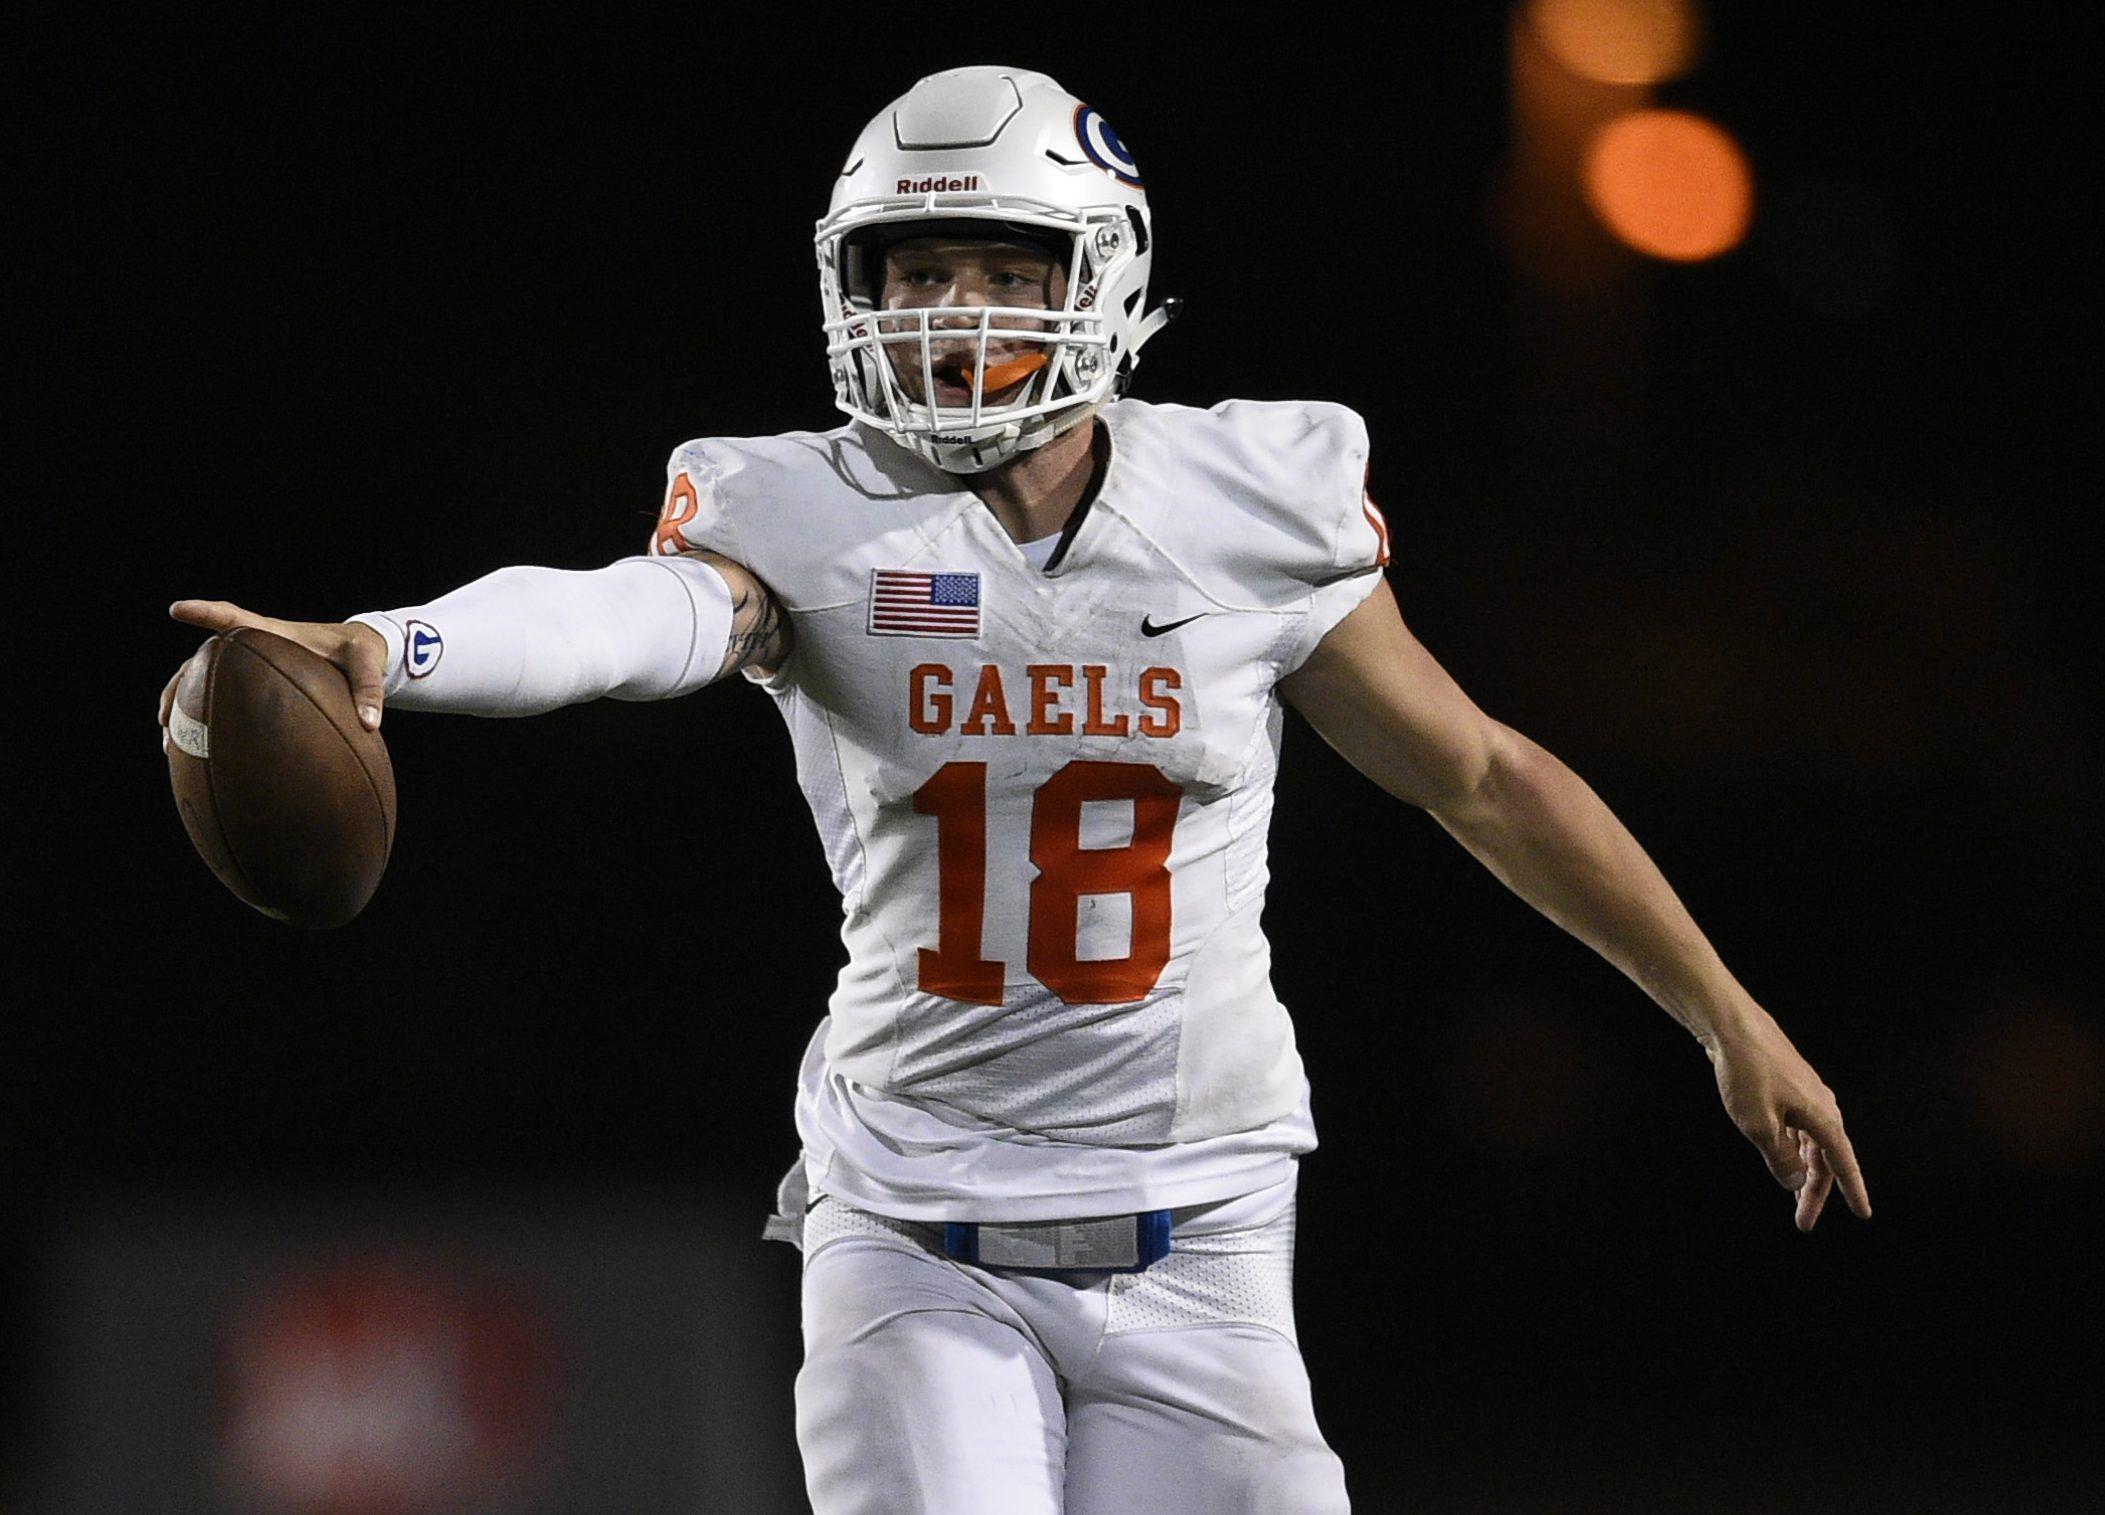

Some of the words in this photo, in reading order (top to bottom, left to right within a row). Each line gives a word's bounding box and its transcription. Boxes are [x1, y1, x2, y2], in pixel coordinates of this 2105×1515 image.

[896, 175, 978, 194] Riddell
[931, 434, 972, 445] Riddell
[909, 663, 1181, 738] GAELS
[912, 760, 1183, 1007] 18
